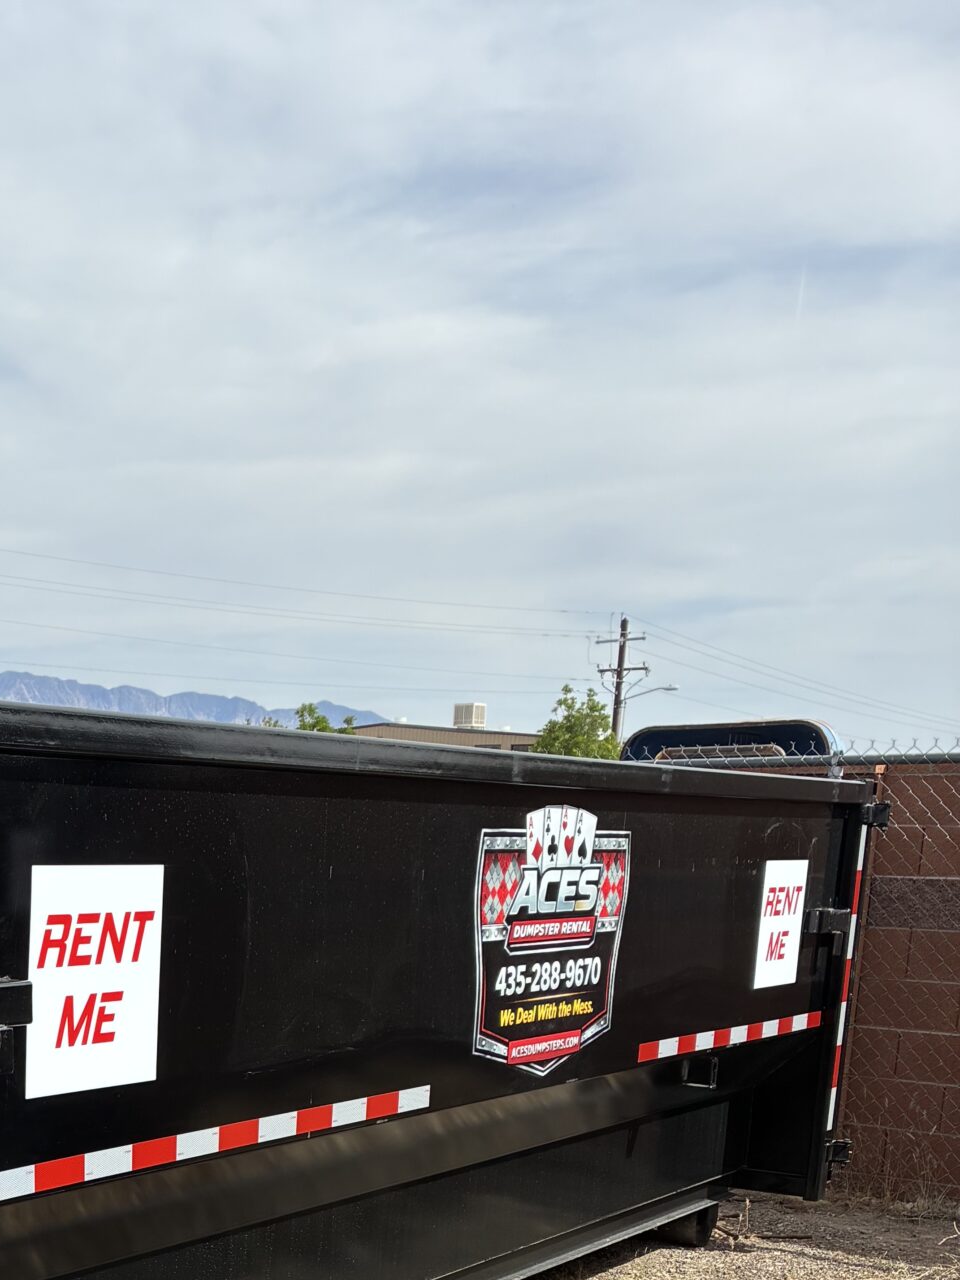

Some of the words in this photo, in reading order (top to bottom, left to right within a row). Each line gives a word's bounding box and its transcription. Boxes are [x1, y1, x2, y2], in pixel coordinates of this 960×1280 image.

[509, 869, 600, 915] ACES
[763, 885, 803, 917] RENT
[37, 911, 155, 969] RENT
[513, 923, 560, 938] DUMPSTER
[561, 920, 592, 934] RENTAL
[765, 930, 789, 962] ME
[494, 956, 602, 996] 435-288-9670
[55, 991, 124, 1048] ME
[500, 1009, 515, 1027] We
[515, 1005, 537, 1025] Deal
[537, 1002, 556, 1021] With
[558, 1001, 570, 1019] the
[572, 999, 593, 1016] Mess.
[511, 1036, 580, 1059] ACESDUMPSTERS.COM
